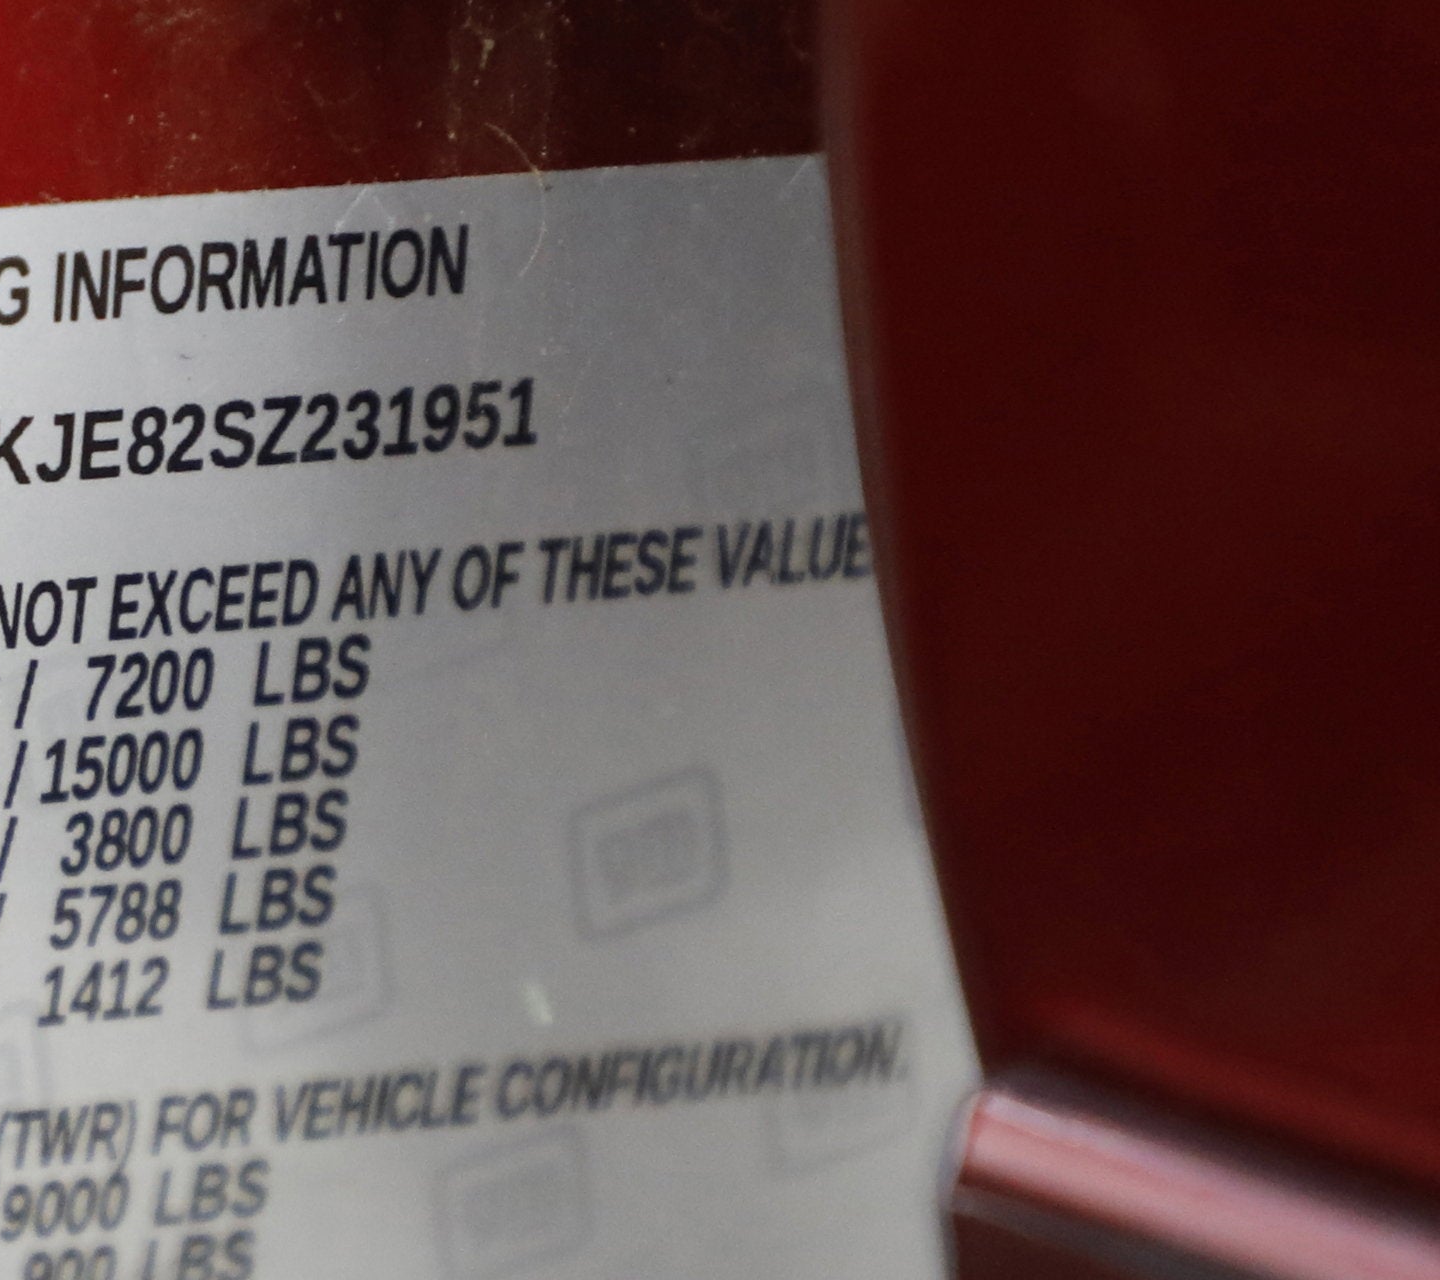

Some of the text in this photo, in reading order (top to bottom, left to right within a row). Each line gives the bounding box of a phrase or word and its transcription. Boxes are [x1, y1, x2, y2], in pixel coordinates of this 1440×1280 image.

[50, 221, 470, 324] INFORMATION
[105, 555, 321, 642] EXCEED
[327, 545, 443, 623] ANY
[448, 538, 526, 613] OF
[534, 522, 705, 606] THESE
[83, 644, 216, 722] 7200
[250, 630, 372, 708] LBS
[36, 724, 205, 806] 15000
[239, 710, 361, 787] LBS
[57, 800, 195, 878] 3800
[227, 785, 350, 862] LBS
[46, 875, 184, 952] 5788
[215, 861, 338, 937] LBS
[33, 953, 171, 1029] 1412
[203, 935, 325, 1012] LBS
[149, 1084, 259, 1155] FOR
[271, 1059, 488, 1143] VEHICLE
[490, 1017, 910, 1123] CONFIGURATION.
[149, 1154, 272, 1229] LBS
